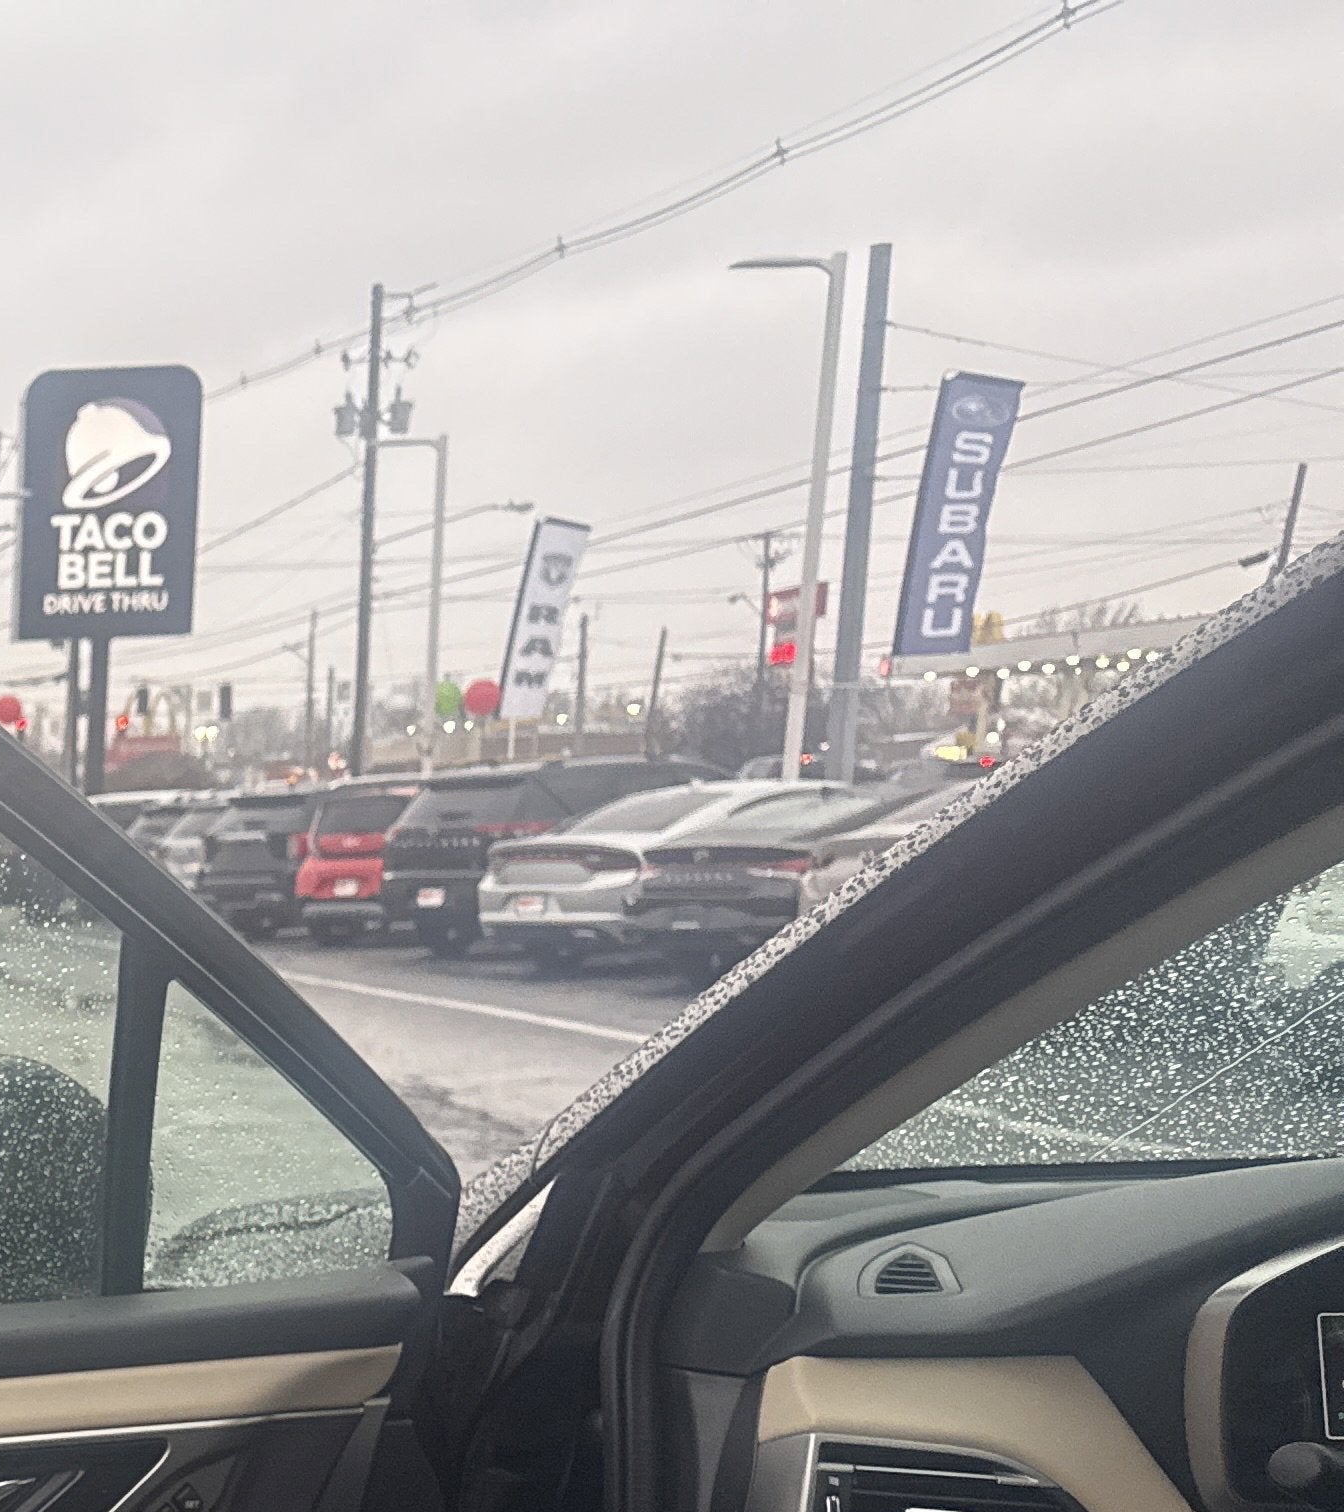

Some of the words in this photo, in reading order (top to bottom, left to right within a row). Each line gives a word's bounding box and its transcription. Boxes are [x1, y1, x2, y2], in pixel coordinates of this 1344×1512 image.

[49, 511, 169, 551] TACO
[920, 430, 994, 639] SUBARU
[57, 551, 165, 590] BELL
[42, 591, 107, 616] DRIVE
[110, 588, 170, 614] THRU
[514, 604, 560, 688] RAM
